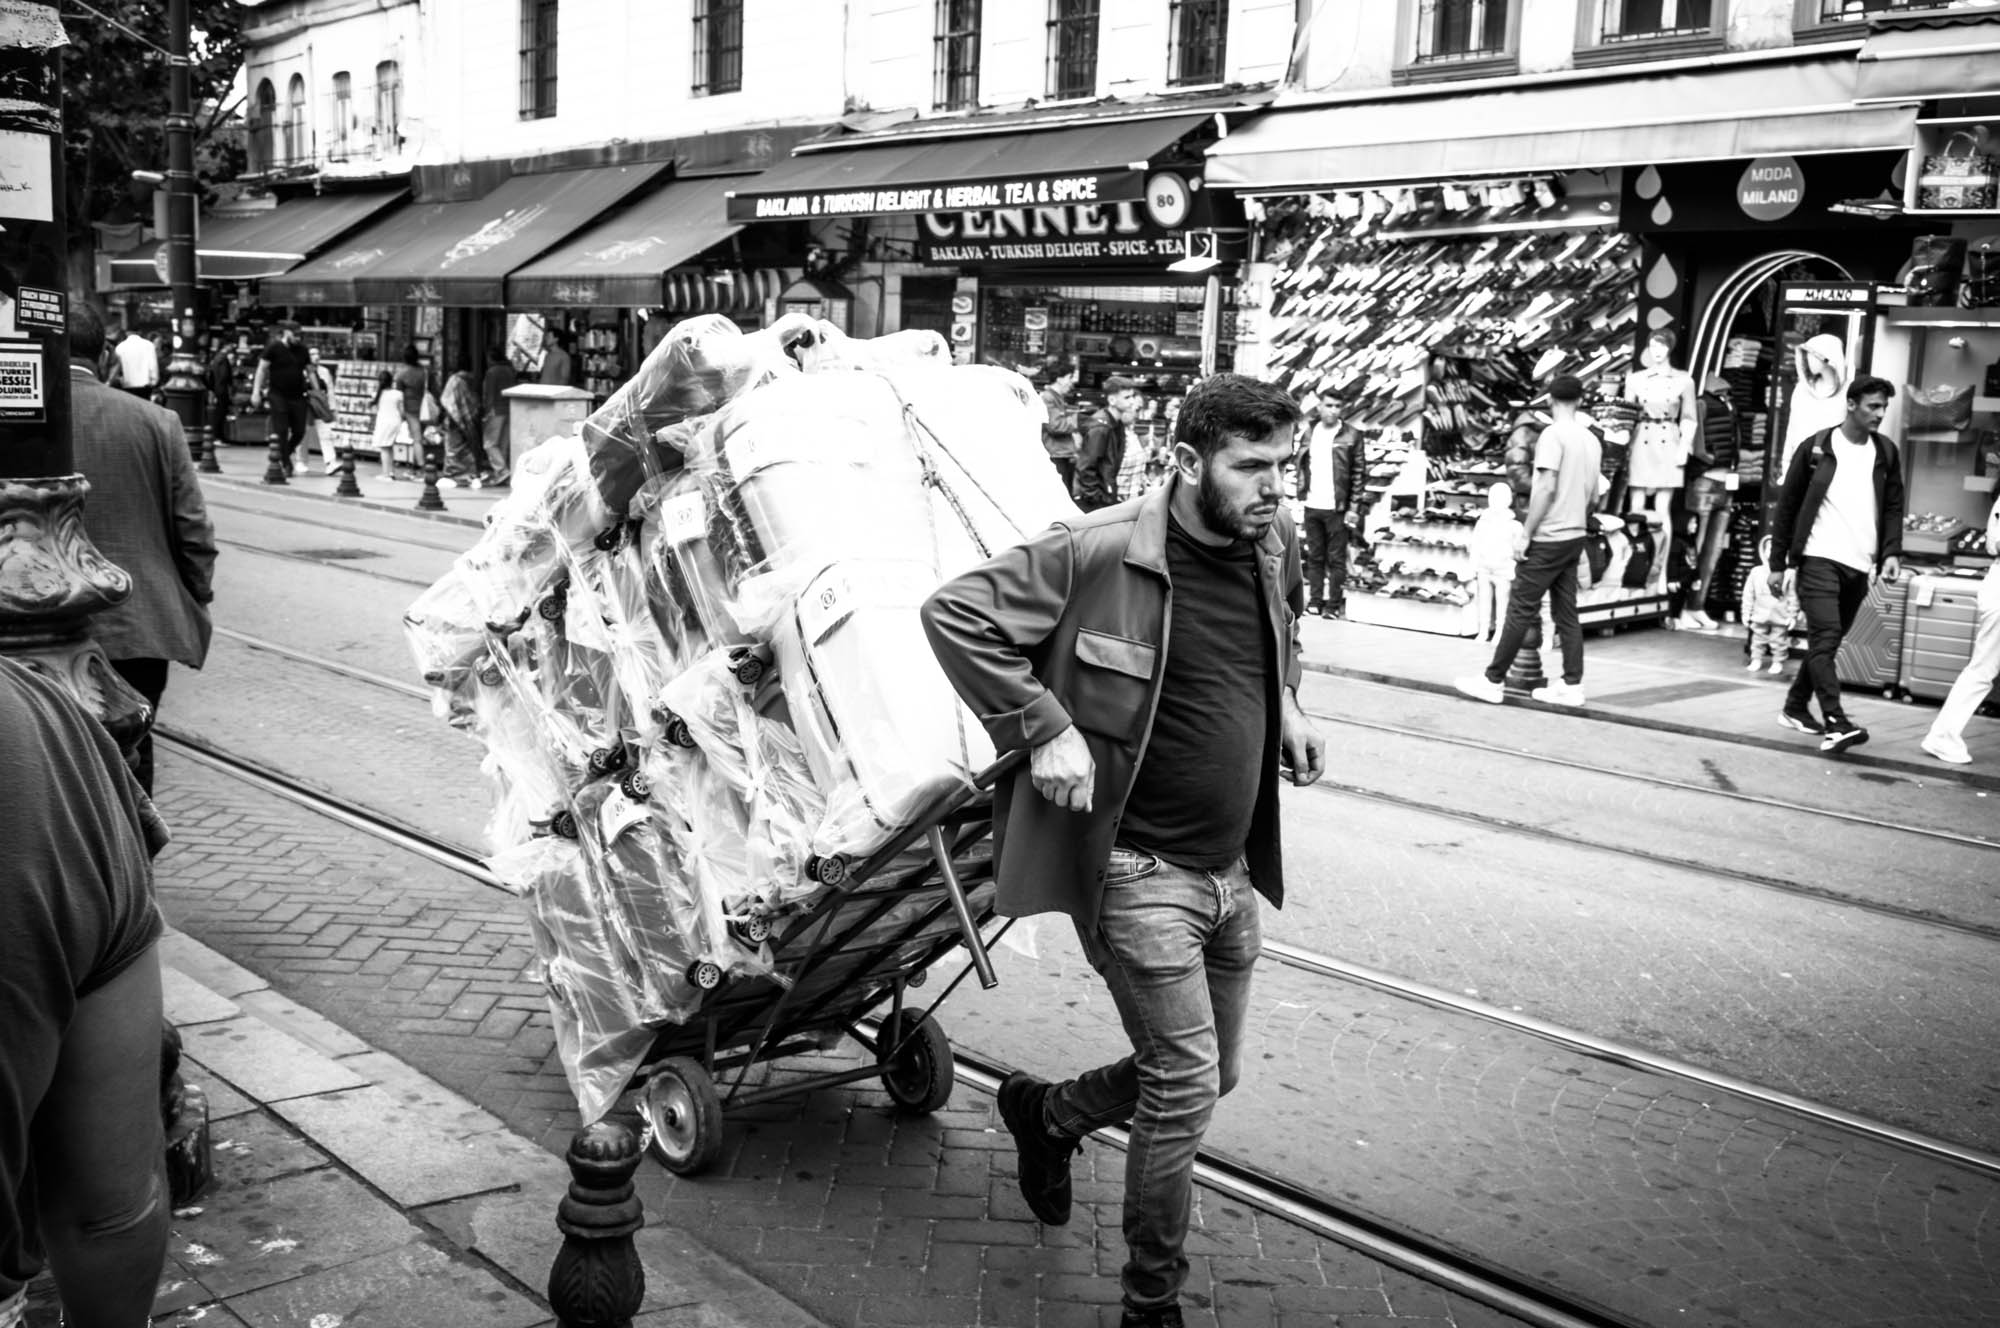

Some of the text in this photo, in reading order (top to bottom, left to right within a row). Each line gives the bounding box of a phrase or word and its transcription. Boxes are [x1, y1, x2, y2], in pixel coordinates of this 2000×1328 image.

[1751, 166, 1793, 182] MODA
[756, 176, 1097, 217] BAKLAVA & TURKISH DELIGHT & HERBAL TEA & SPICE
[1156, 194, 1175, 207] 80
[1742, 188, 1798, 204] MILANO
[930, 238, 1185, 260] BAKLAVA TURKISH DELIGHT SPICE TEA
[1804, 288, 1853, 301] MILANO
